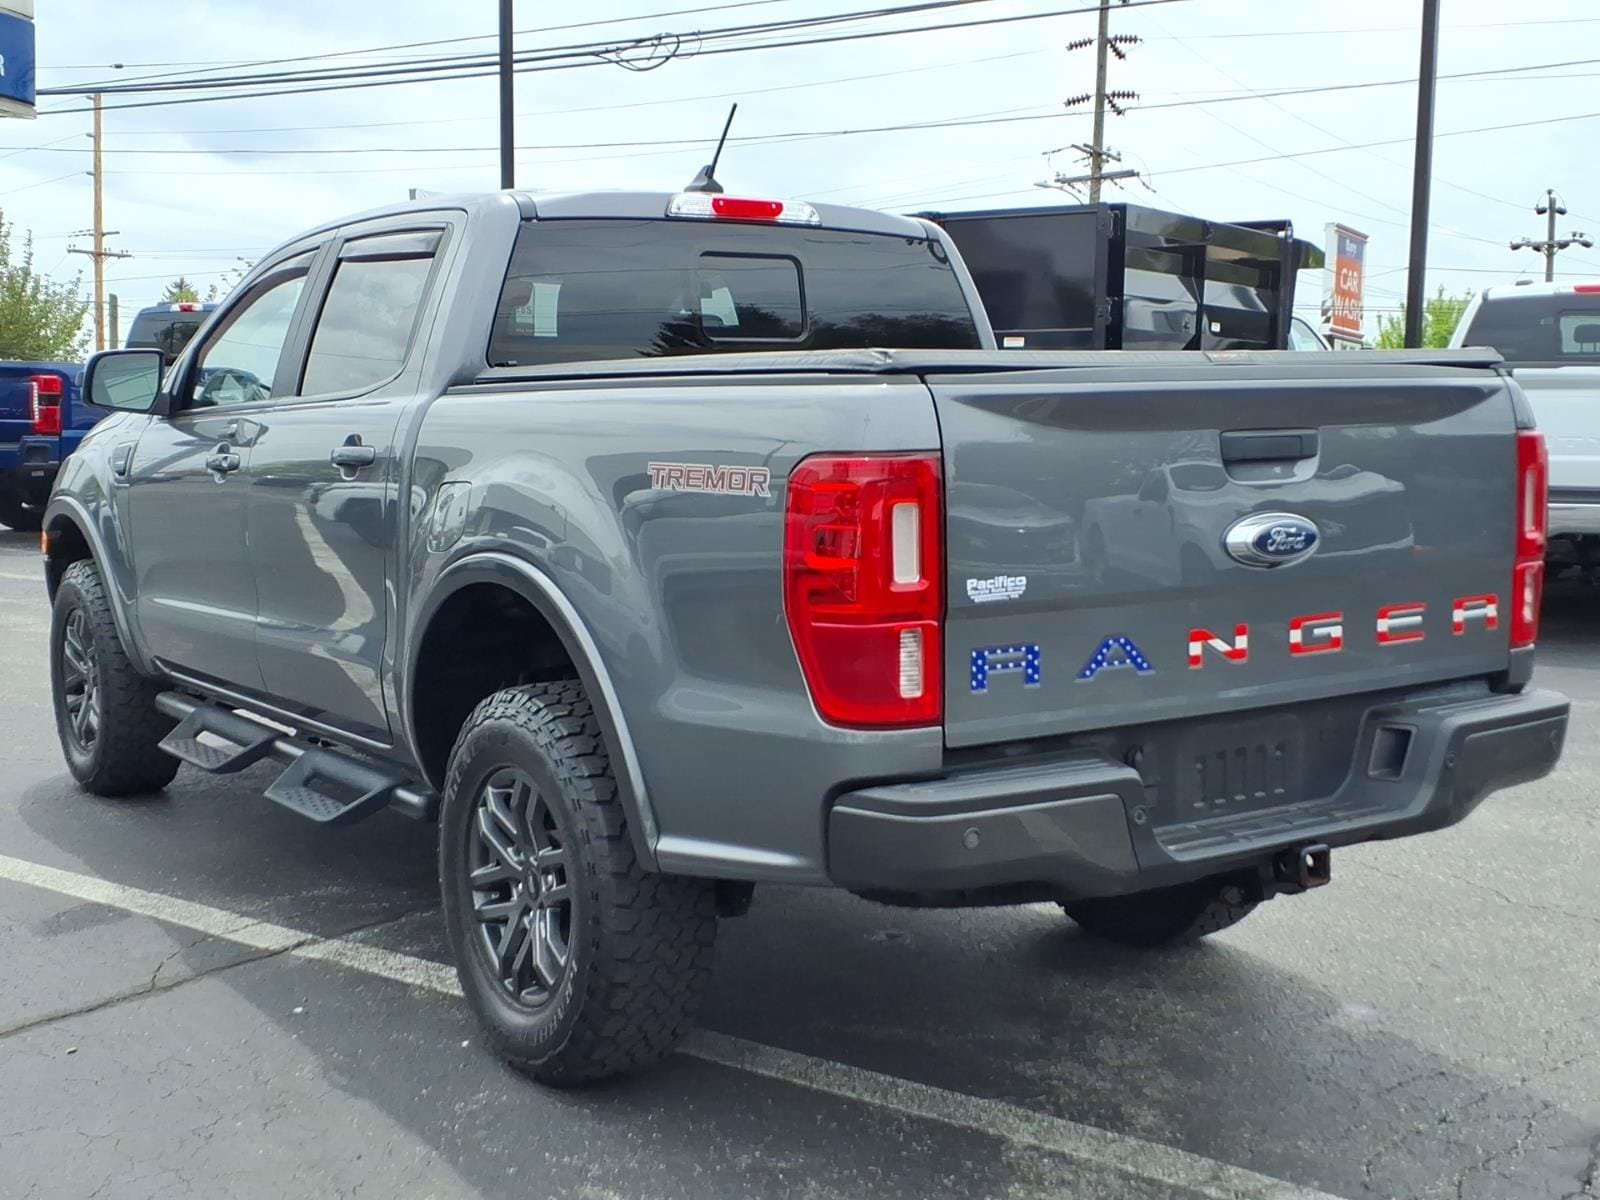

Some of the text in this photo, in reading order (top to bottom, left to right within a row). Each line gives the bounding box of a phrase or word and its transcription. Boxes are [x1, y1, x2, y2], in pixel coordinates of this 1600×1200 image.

[1340, 267, 1359, 294] CAR
[1333, 294, 1362, 321] WASH
[647, 461, 771, 498] TREMOR
[1266, 526, 1307, 552] Ford
[966, 575, 1027, 591] Pacifico
[970, 593, 1499, 694] RANGER
